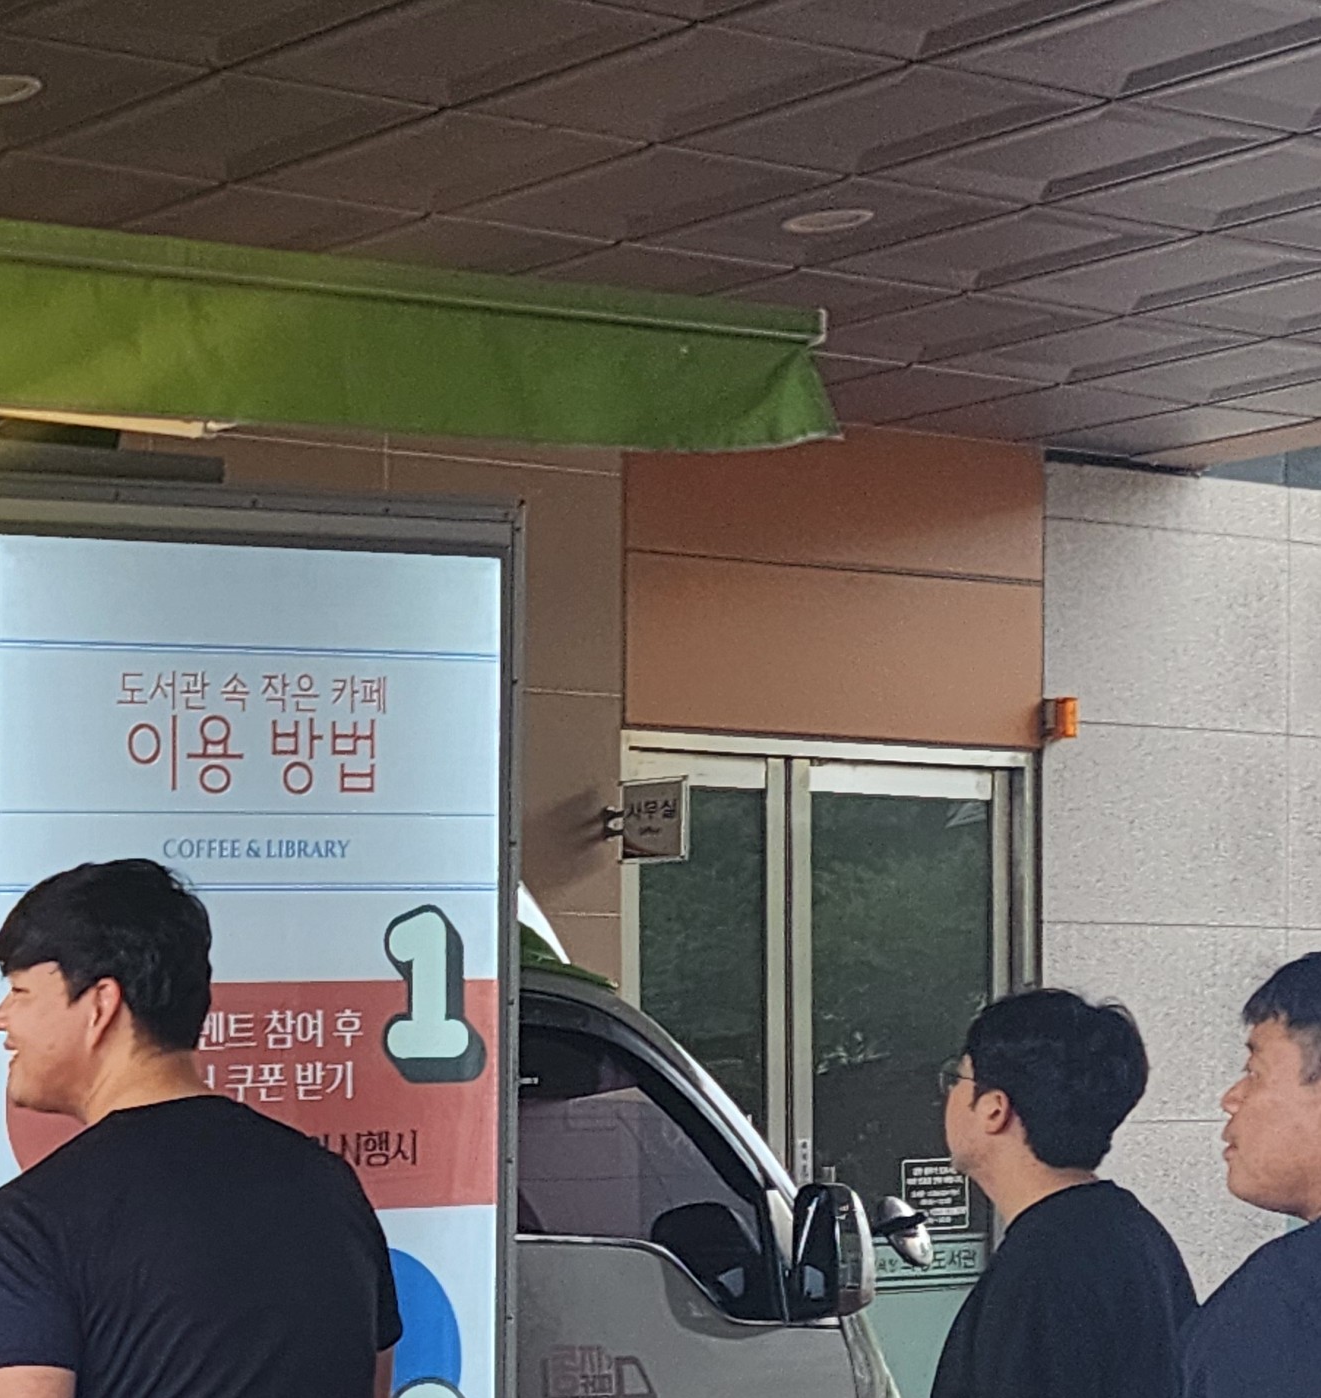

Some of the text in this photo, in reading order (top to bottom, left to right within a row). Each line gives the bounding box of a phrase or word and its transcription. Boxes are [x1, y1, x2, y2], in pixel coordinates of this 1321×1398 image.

[116, 670, 388, 714] 도서관 속 작은 카페
[127, 714, 376, 796] 이용 방법
[163, 839, 350, 859] COFFEE & LIBRARY
[384, 904, 486, 1083] 1
[198, 1009, 364, 1051] 벤트 참여 후
[225, 1063, 288, 1103] 쿠폰
[295, 1060, 354, 1101] 받기
